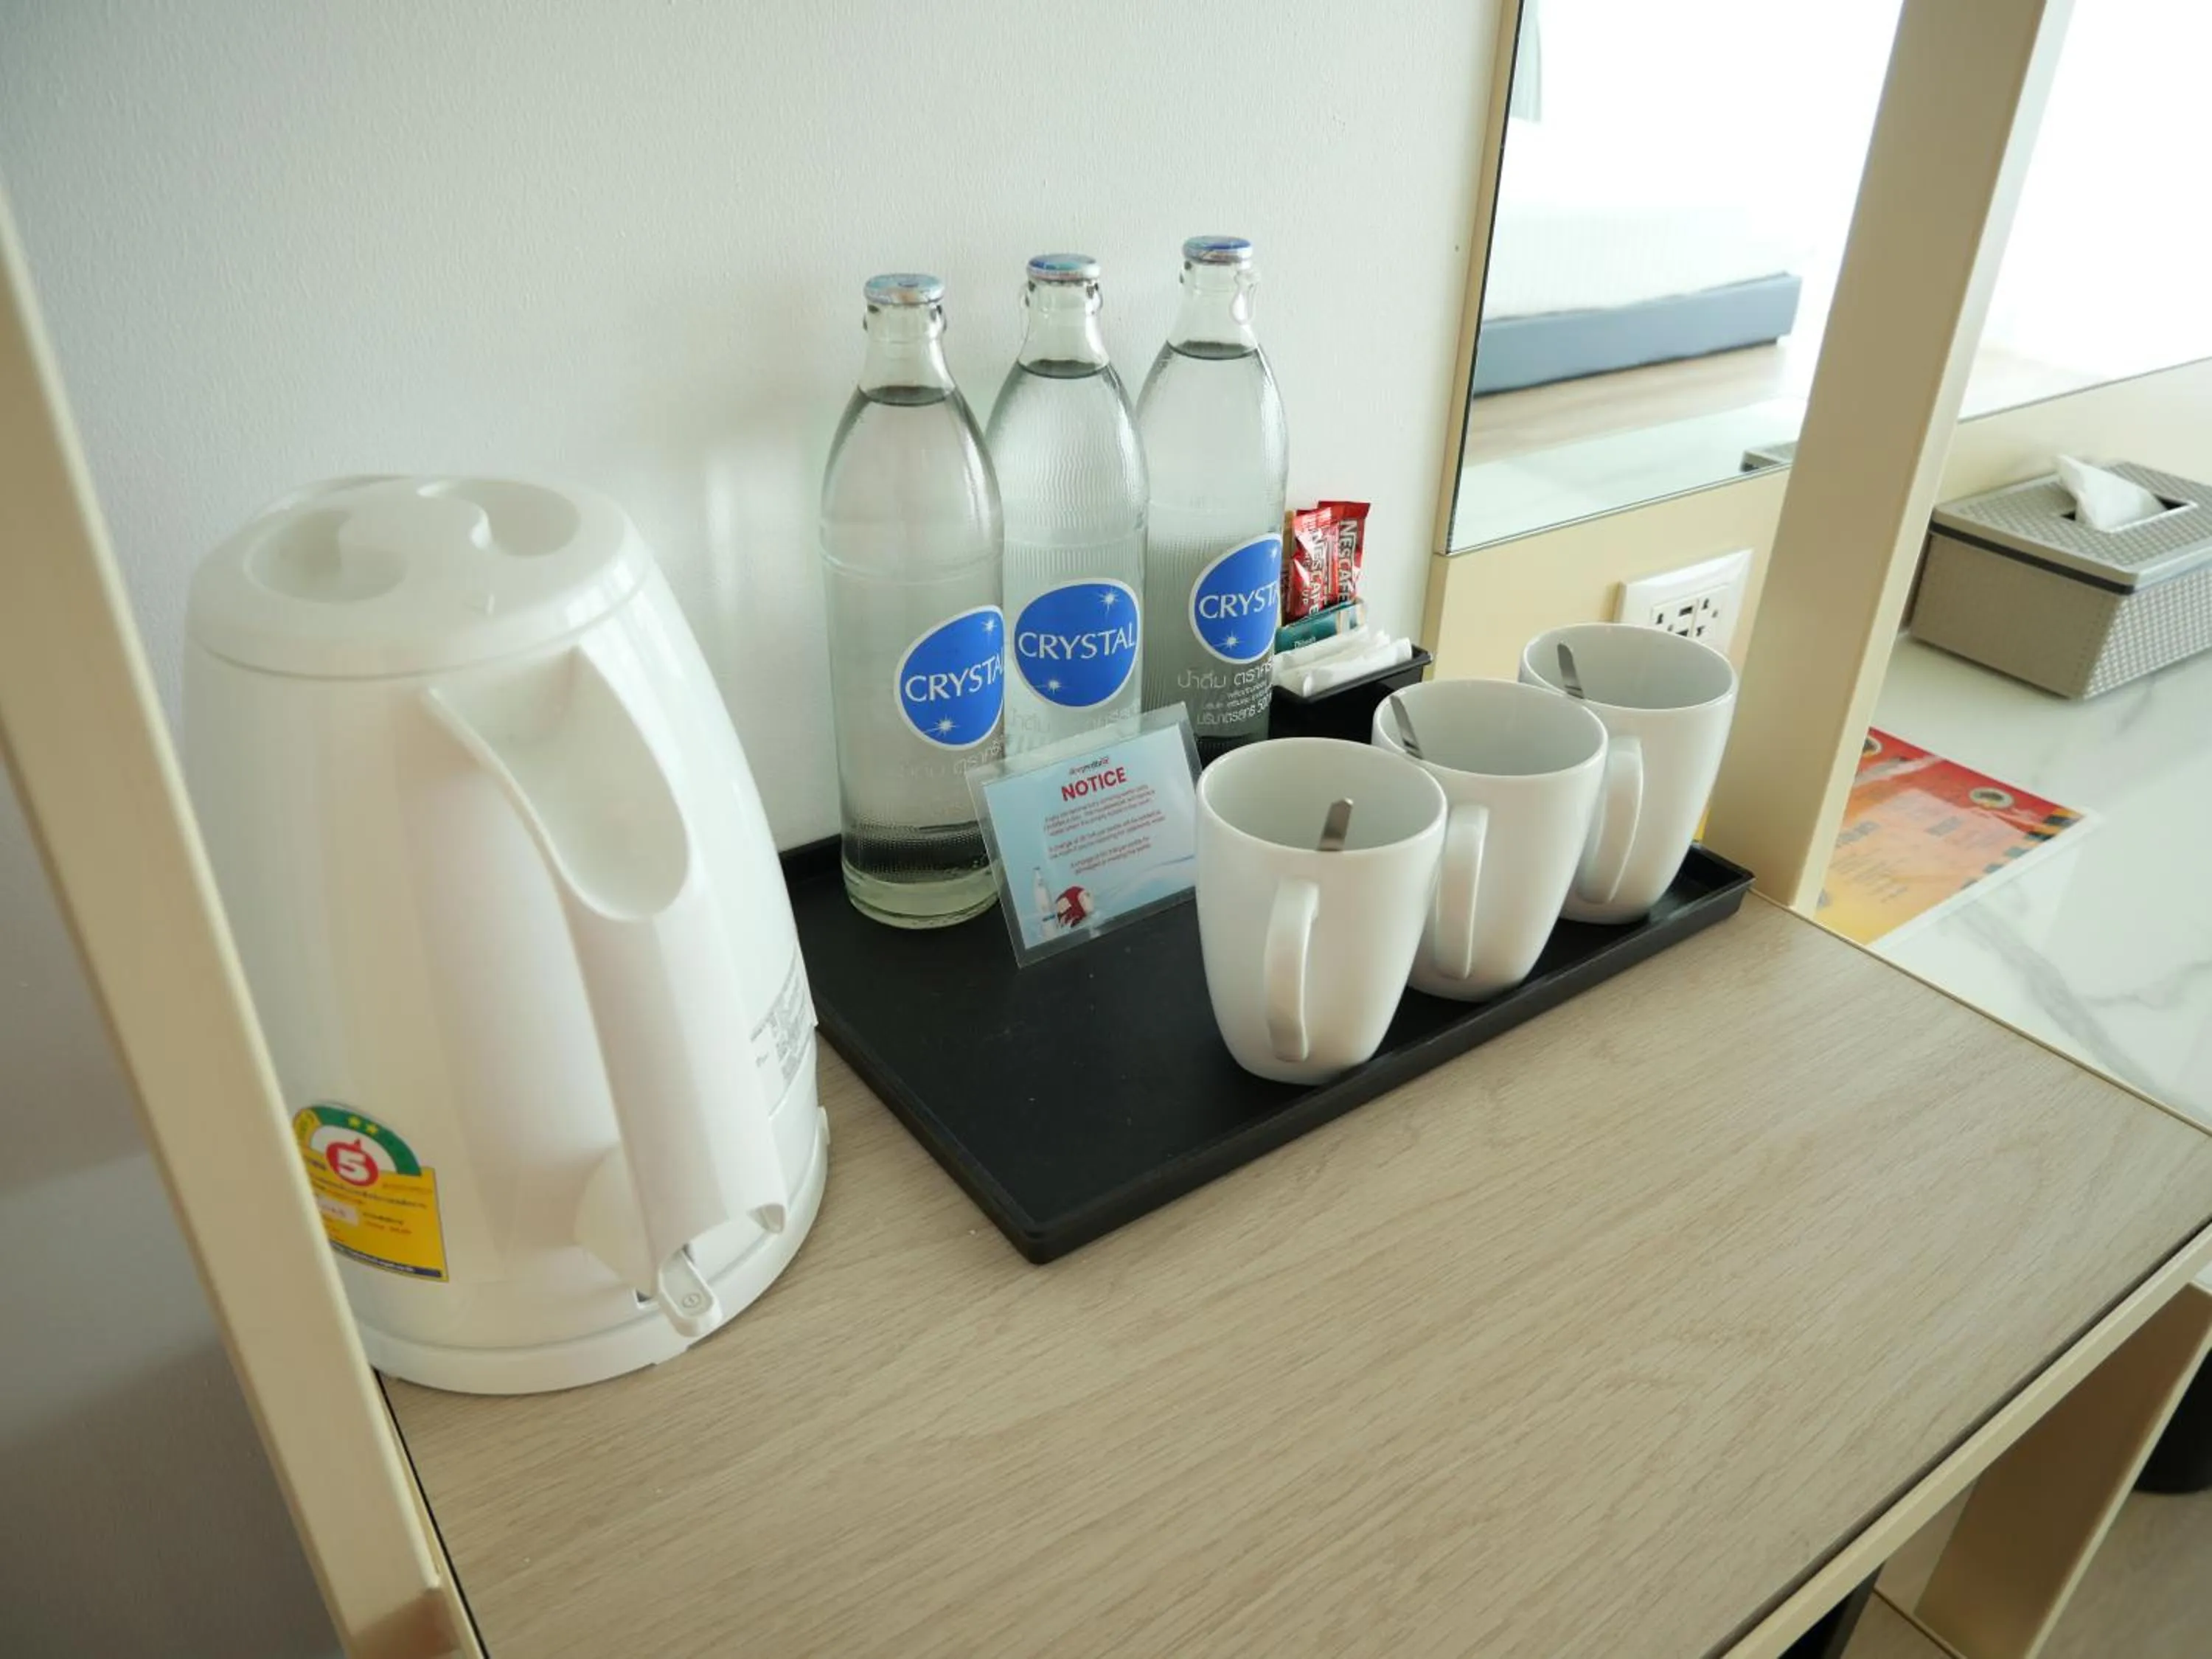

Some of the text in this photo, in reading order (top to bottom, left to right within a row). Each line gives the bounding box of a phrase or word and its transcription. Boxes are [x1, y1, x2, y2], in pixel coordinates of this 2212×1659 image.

[1199, 580, 1277, 619] CRYST
[1018, 622, 1136, 660] CRYSTAL
[1061, 766, 1127, 802] NOTICE
[337, 1149, 370, 1181] 5
